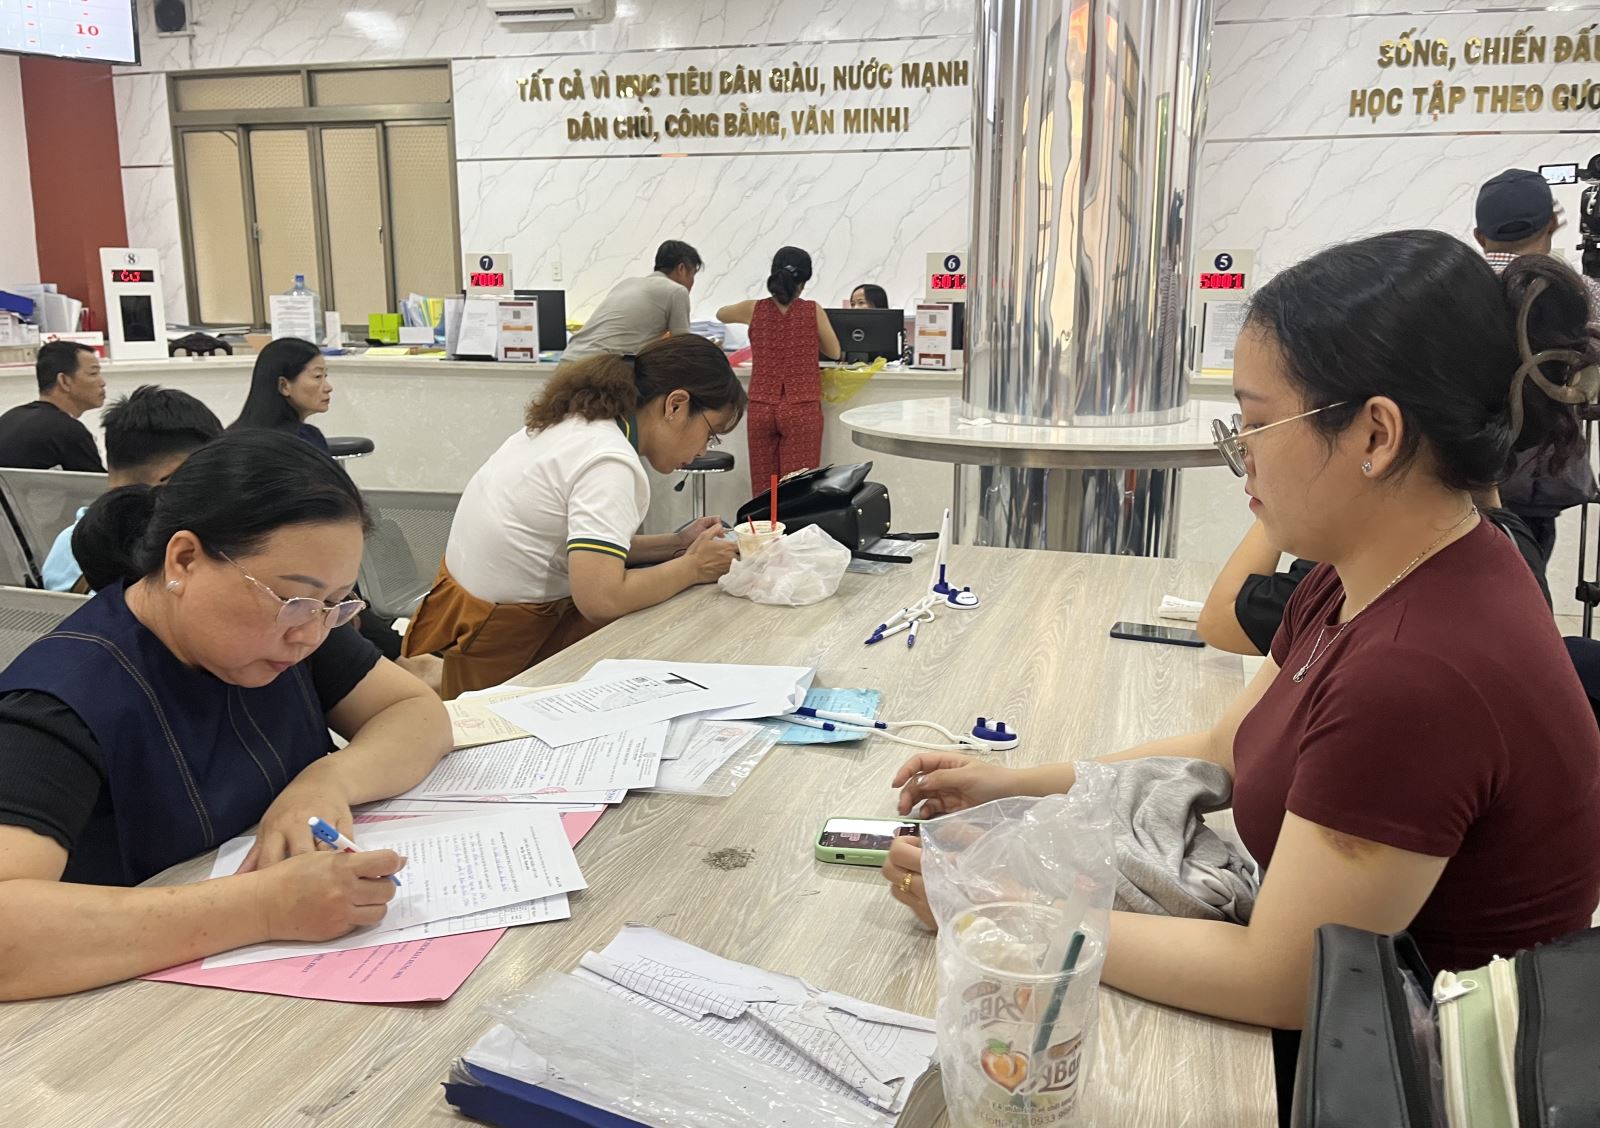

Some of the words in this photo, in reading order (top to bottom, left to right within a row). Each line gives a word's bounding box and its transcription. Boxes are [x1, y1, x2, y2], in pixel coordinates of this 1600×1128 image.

[76, 23, 99, 36] 10
[1377, 27, 1456, 71] SỐNG,
[1464, 25, 1546, 65] CHIẾN
[516, 68, 553, 101] TẤT
[559, 68, 585, 100] CẢ
[590, 69, 610, 99] VÌ
[616, 73, 660, 103] MỤC
[666, 65, 712, 96] TIÊU
[720, 64, 761, 94] DÂN
[769, 61, 826, 96] GIÀU,
[833, 57, 893, 91] NƯỚC
[901, 60, 969, 93] MẠNH
[1350, 88, 1403, 123] HỌC
[1413, 79, 1466, 121] TẬP
[1473, 83, 1543, 114] THEO
[567, 111, 608, 141] DÂN
[613, 106, 659, 142] CHỦ,
[665, 108, 719, 138] CÔNG
[724, 102, 787, 140] BẰNG,
[791, 105, 835, 135] VĂN
[843, 106, 909, 134] MINH!
[127, 253, 136, 264] 8
[482, 258, 490, 269] 7
[947, 257, 956, 269] 6
[1219, 256, 1229, 268] 5
[470, 272, 504, 287] 7001
[1200, 272, 1243, 289] 5001
